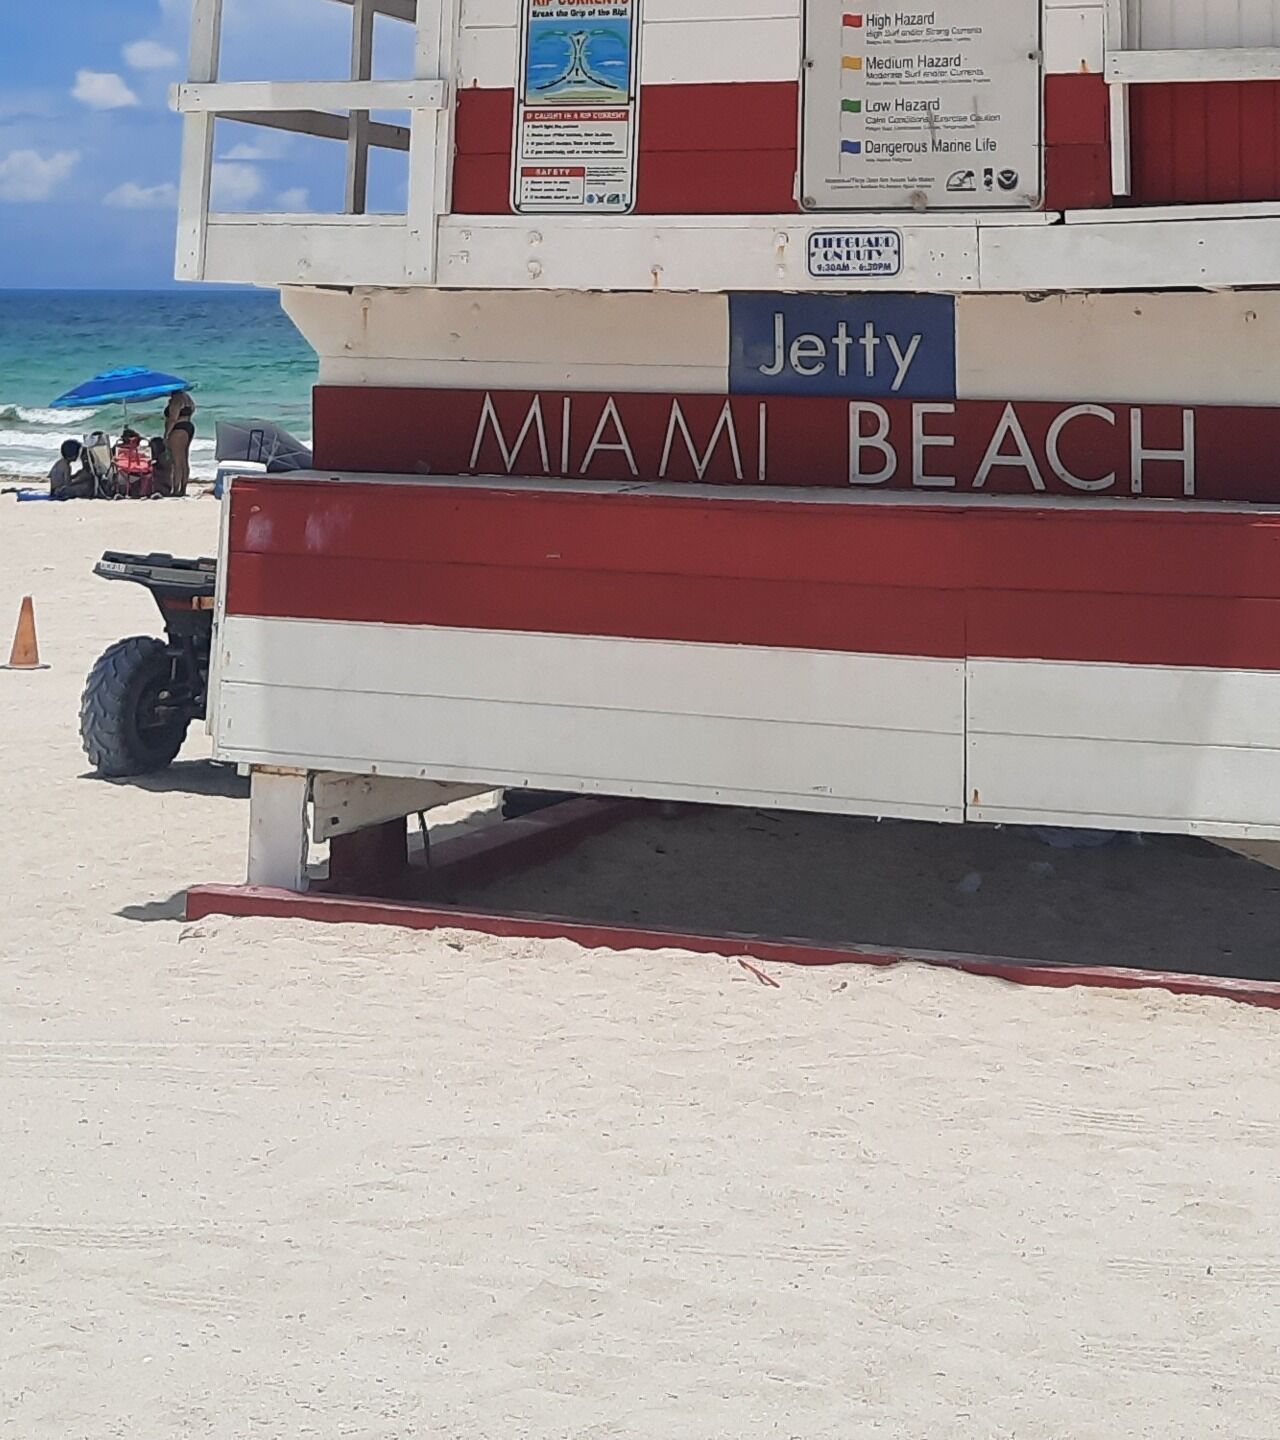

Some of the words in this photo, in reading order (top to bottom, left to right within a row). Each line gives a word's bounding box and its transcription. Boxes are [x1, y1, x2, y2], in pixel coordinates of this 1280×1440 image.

[532, 9, 554, 18] Break
[556, 9, 568, 17] the
[570, 9, 586, 18] Grip
[588, 8, 596, 17] of
[598, 8, 610, 16] the
[866, 13, 891, 30] High
[895, 11, 935, 26] Hazard
[866, 56, 913, 69] Medium
[917, 54, 961, 67] Hazard
[865, 99, 891, 112] Low
[895, 98, 940, 111] Hazard
[865, 140, 927, 156] Dangerous
[931, 139, 972, 153] Marine
[975, 138, 997, 152] Life
[535, 168, 571, 176] SAFETY
[814, 236, 895, 249] LIFEGUARD
[823, 250, 843, 261] ON
[846, 249, 884, 261] DUTY
[759, 313, 922, 391] Jetty
[469, 392, 768, 481] MIAMI
[849, 400, 1196, 496] BEACH
